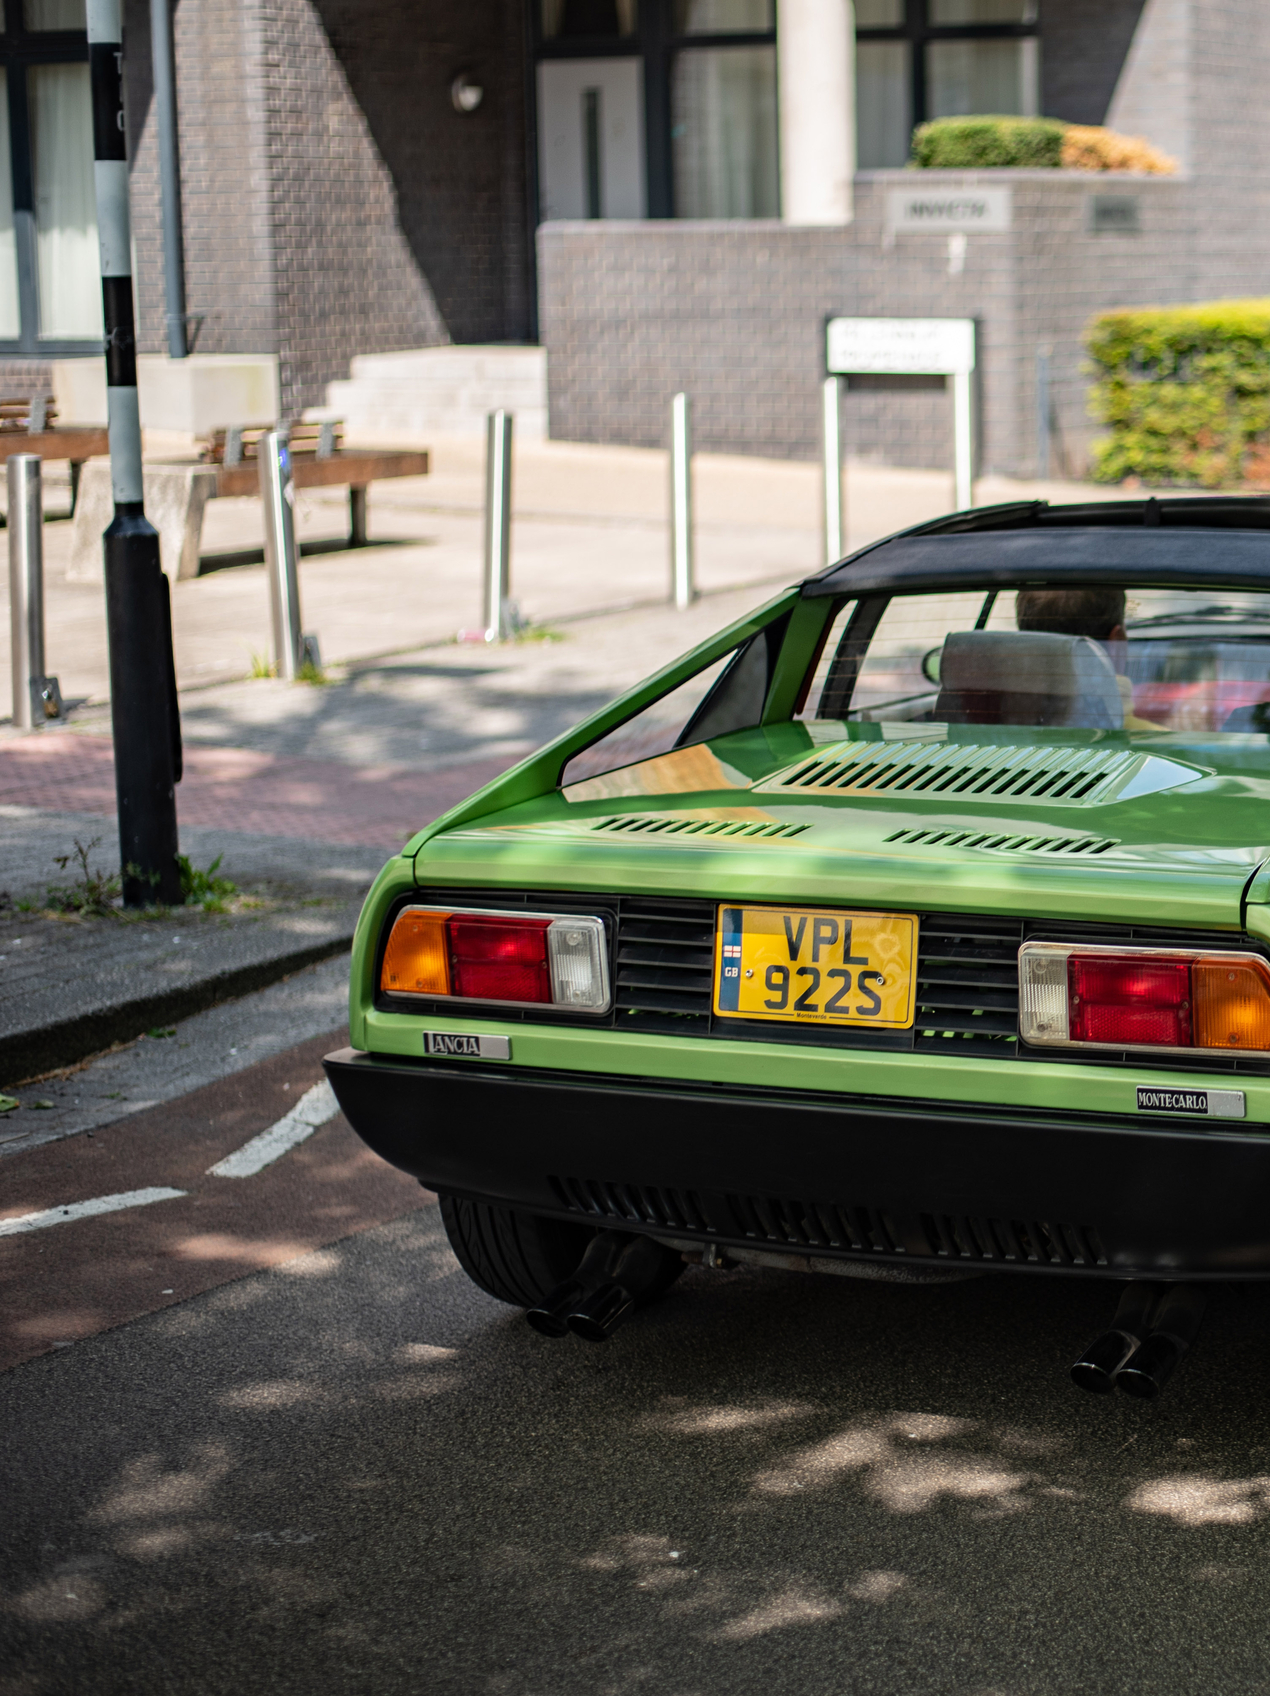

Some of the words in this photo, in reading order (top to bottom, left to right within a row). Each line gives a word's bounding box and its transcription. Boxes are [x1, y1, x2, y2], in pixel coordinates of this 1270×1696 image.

[783, 916, 868, 965] VPL
[724, 967, 739, 978] GB
[763, 965, 882, 1016] 922S
[428, 1032, 480, 1056] LANCIA
